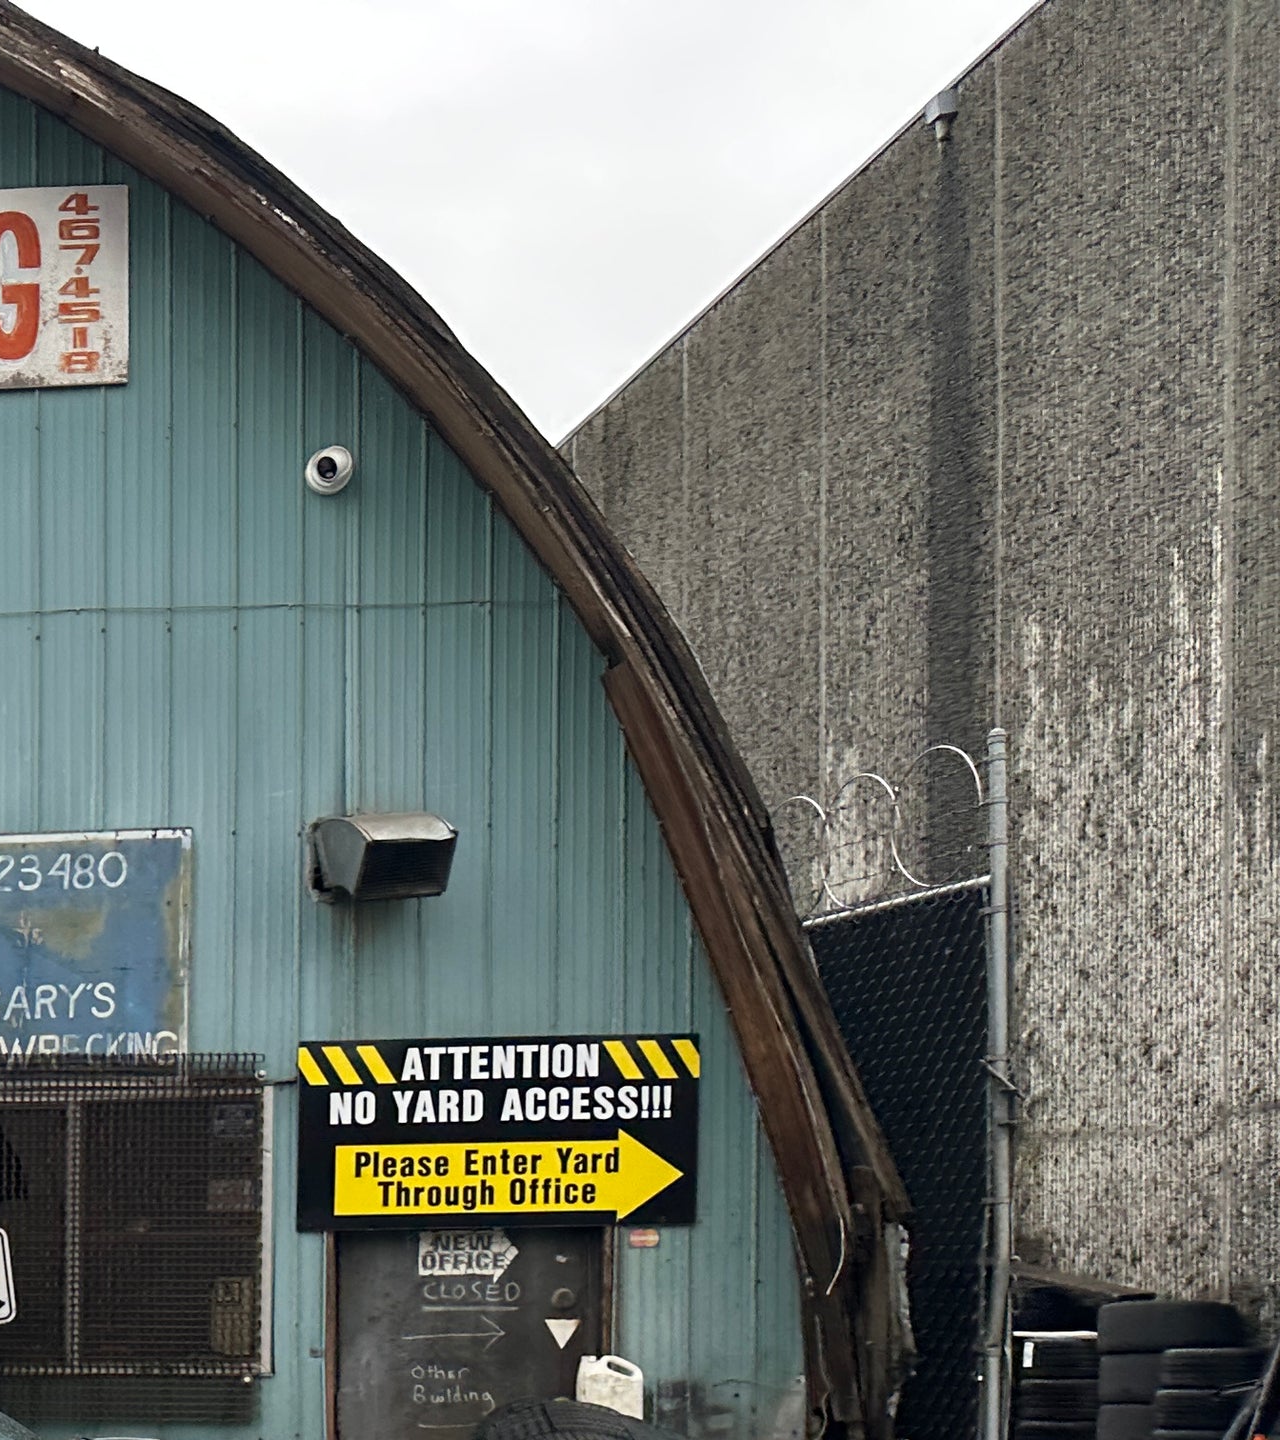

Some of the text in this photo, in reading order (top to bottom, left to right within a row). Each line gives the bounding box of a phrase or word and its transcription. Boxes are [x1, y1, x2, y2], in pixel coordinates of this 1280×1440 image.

[401, 1043, 600, 1081] ATTENTION
[329, 1085, 672, 1125] NO YARD ACCESS!!!
[354, 1146, 620, 1178] Please Enter Yard
[378, 1177, 596, 1210] Through Office
[432, 1233, 490, 1251] NEW
[421, 1250, 506, 1271] OFFICE
[423, 1281, 520, 1302] CLOSED
